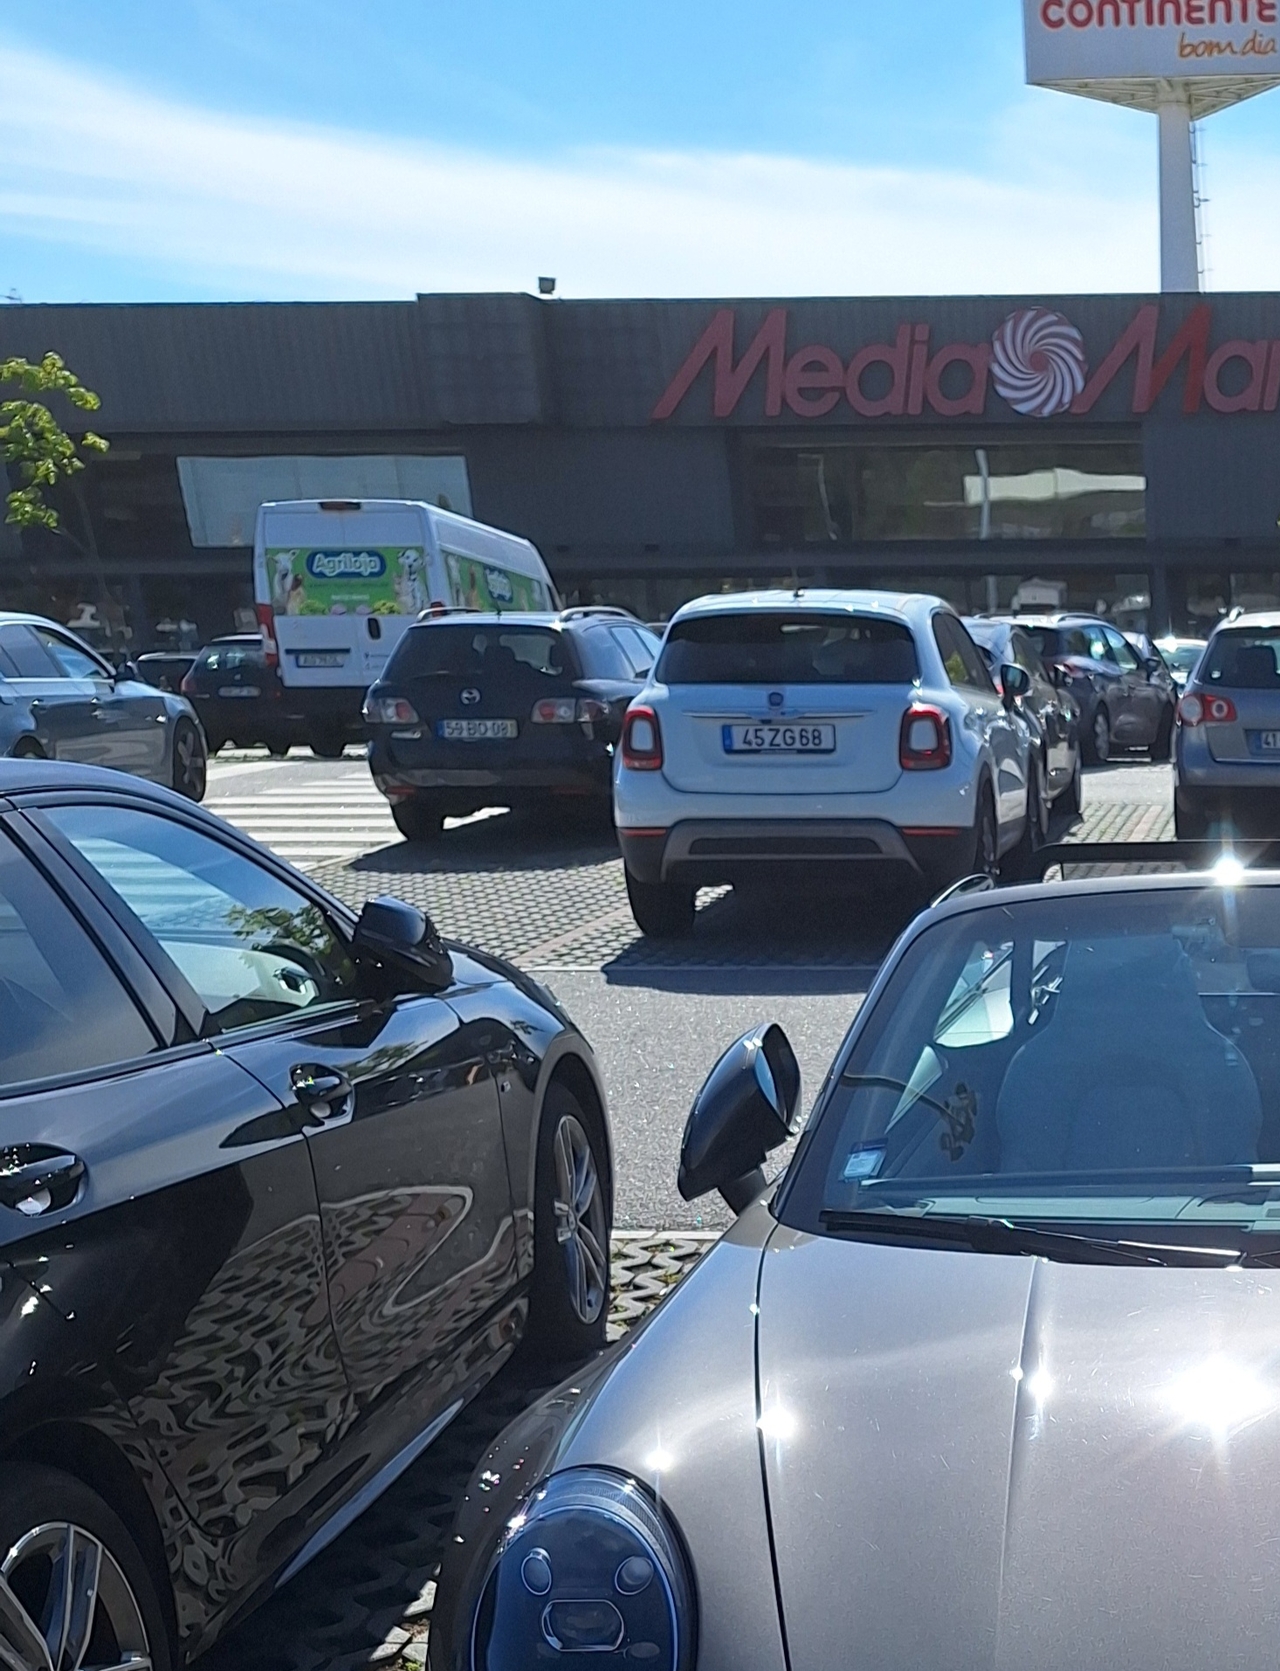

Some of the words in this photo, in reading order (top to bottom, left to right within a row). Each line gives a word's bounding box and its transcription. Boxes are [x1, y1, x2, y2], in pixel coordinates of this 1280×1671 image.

[1041, 0, 1276, 28] CONTINENTE
[1179, 33, 1238, 58] bom
[1241, 29, 1277, 56] dia
